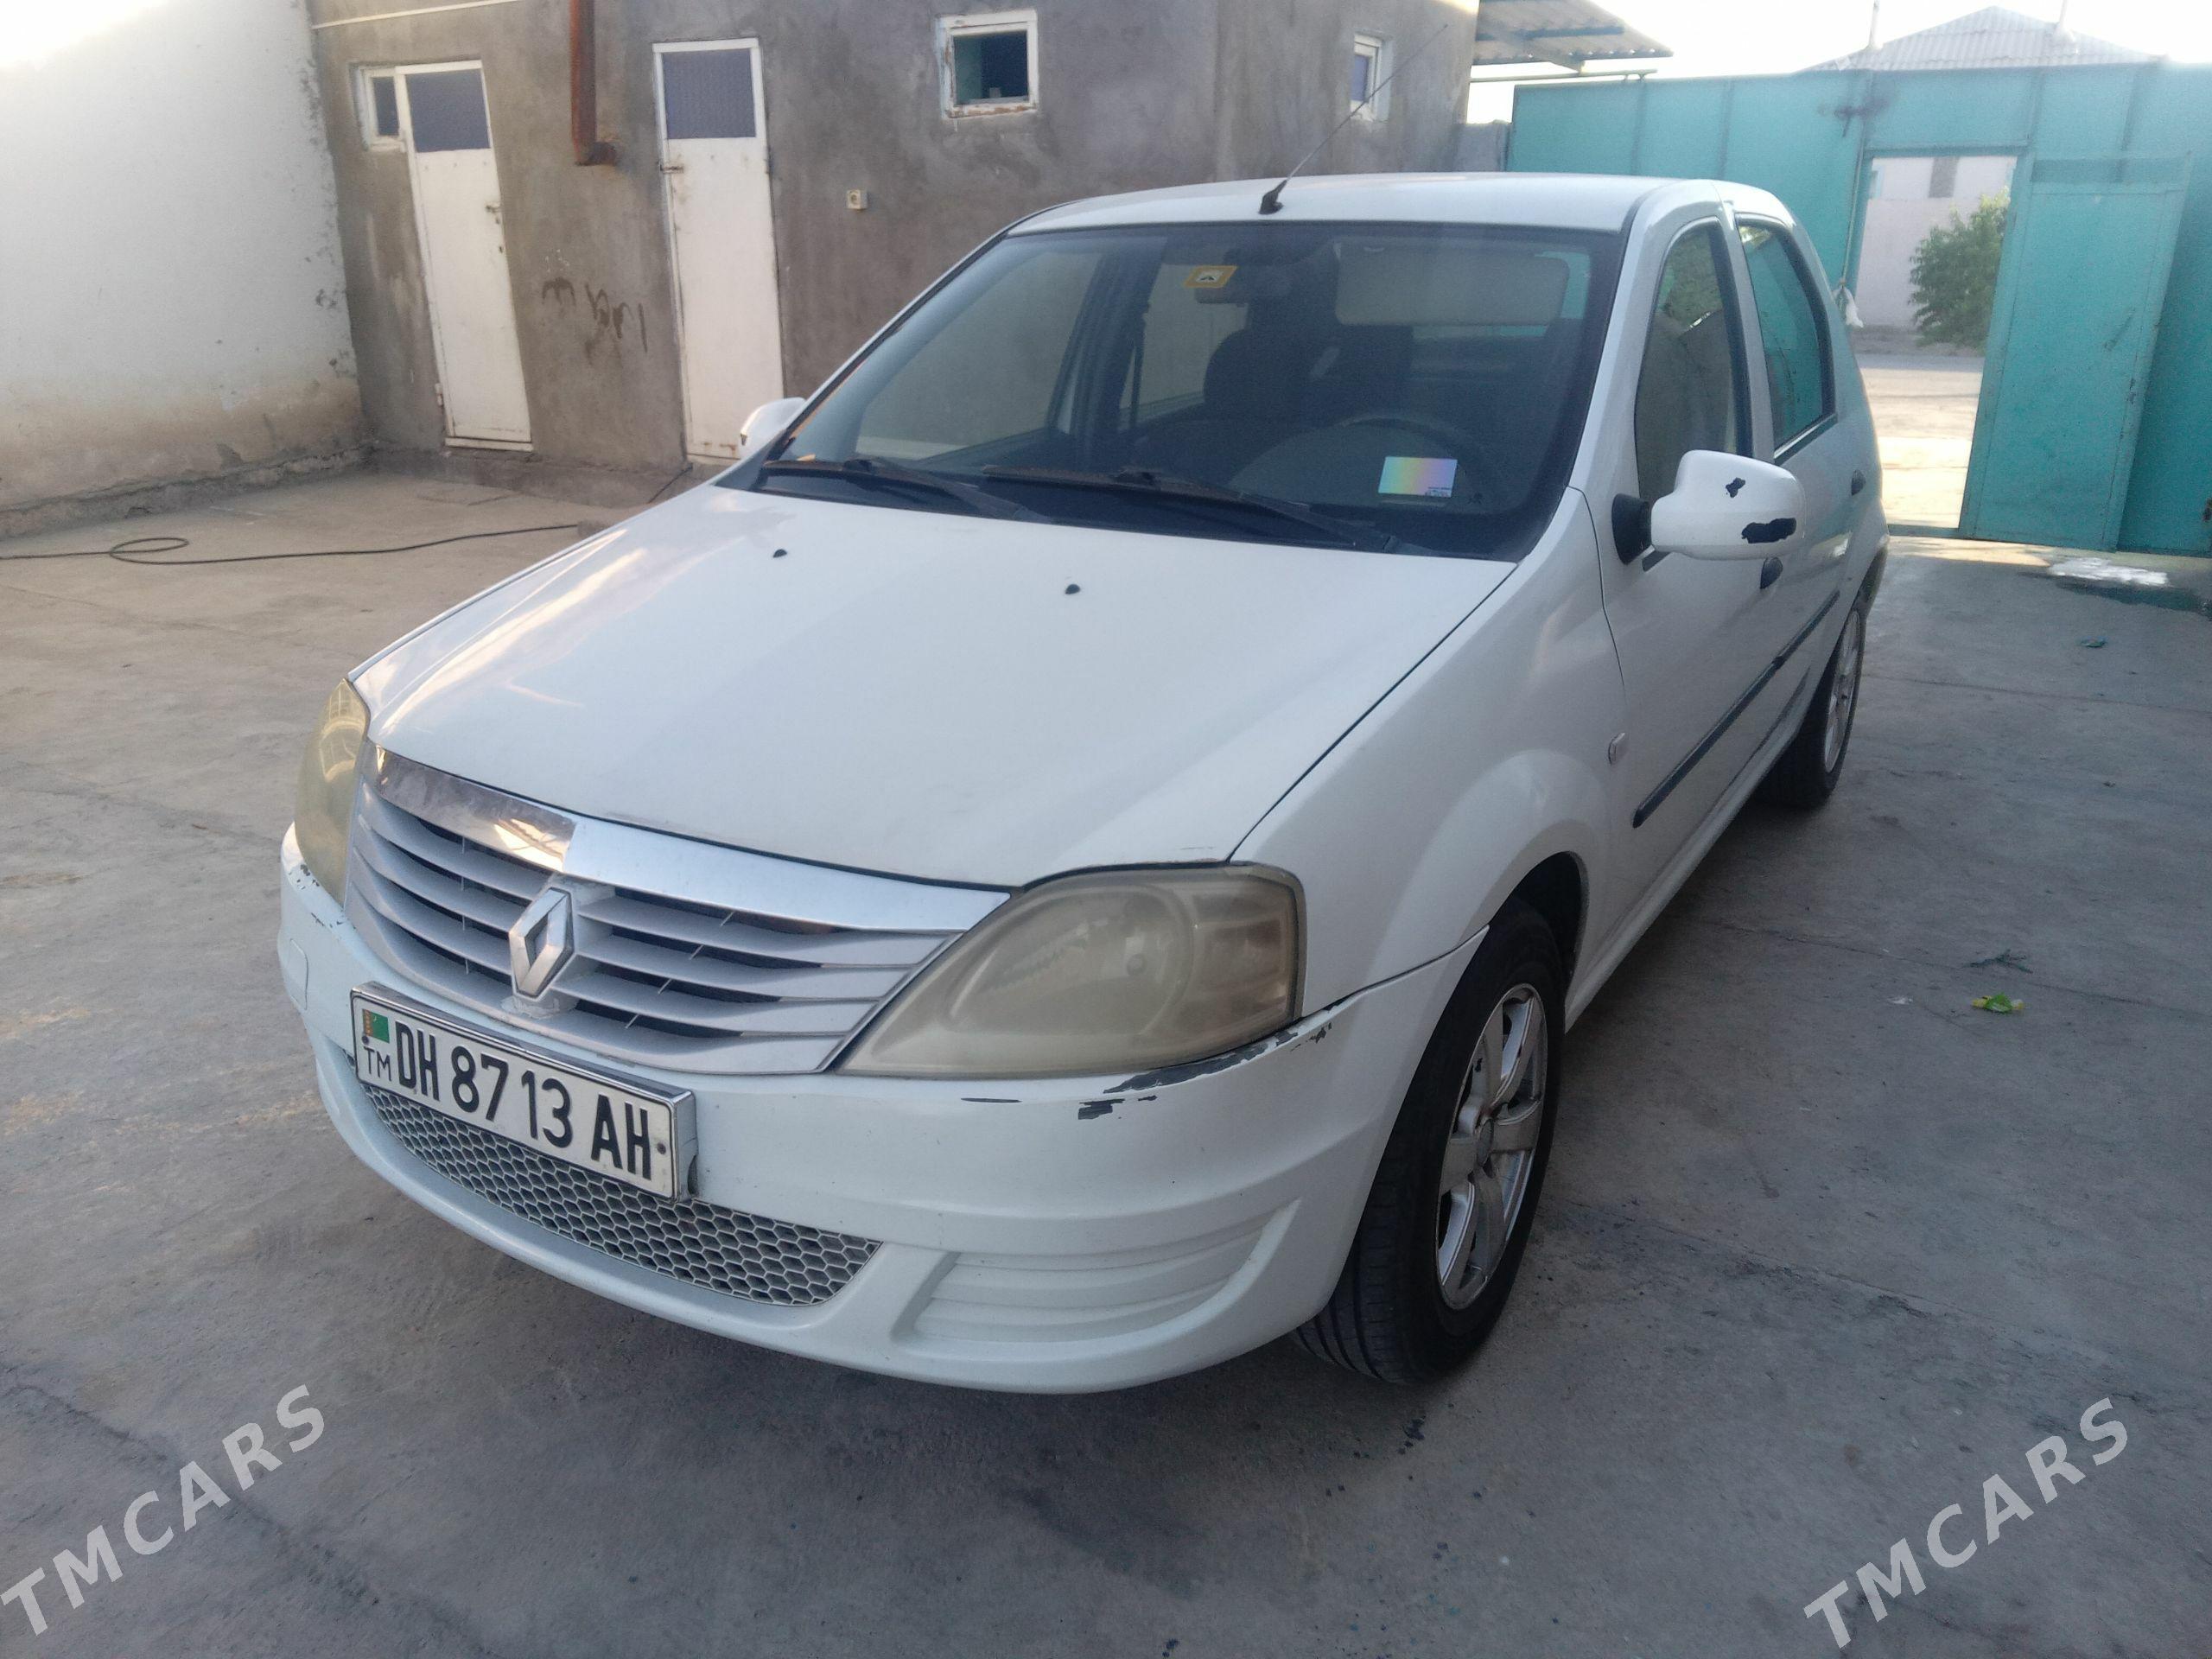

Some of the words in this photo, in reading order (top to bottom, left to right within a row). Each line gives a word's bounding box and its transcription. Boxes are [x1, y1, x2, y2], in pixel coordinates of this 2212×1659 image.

[363, 1046, 392, 1082] TM
[395, 1020, 440, 1102] DH
[450, 1046, 573, 1149] 8713
[591, 1094, 652, 1181] AH
